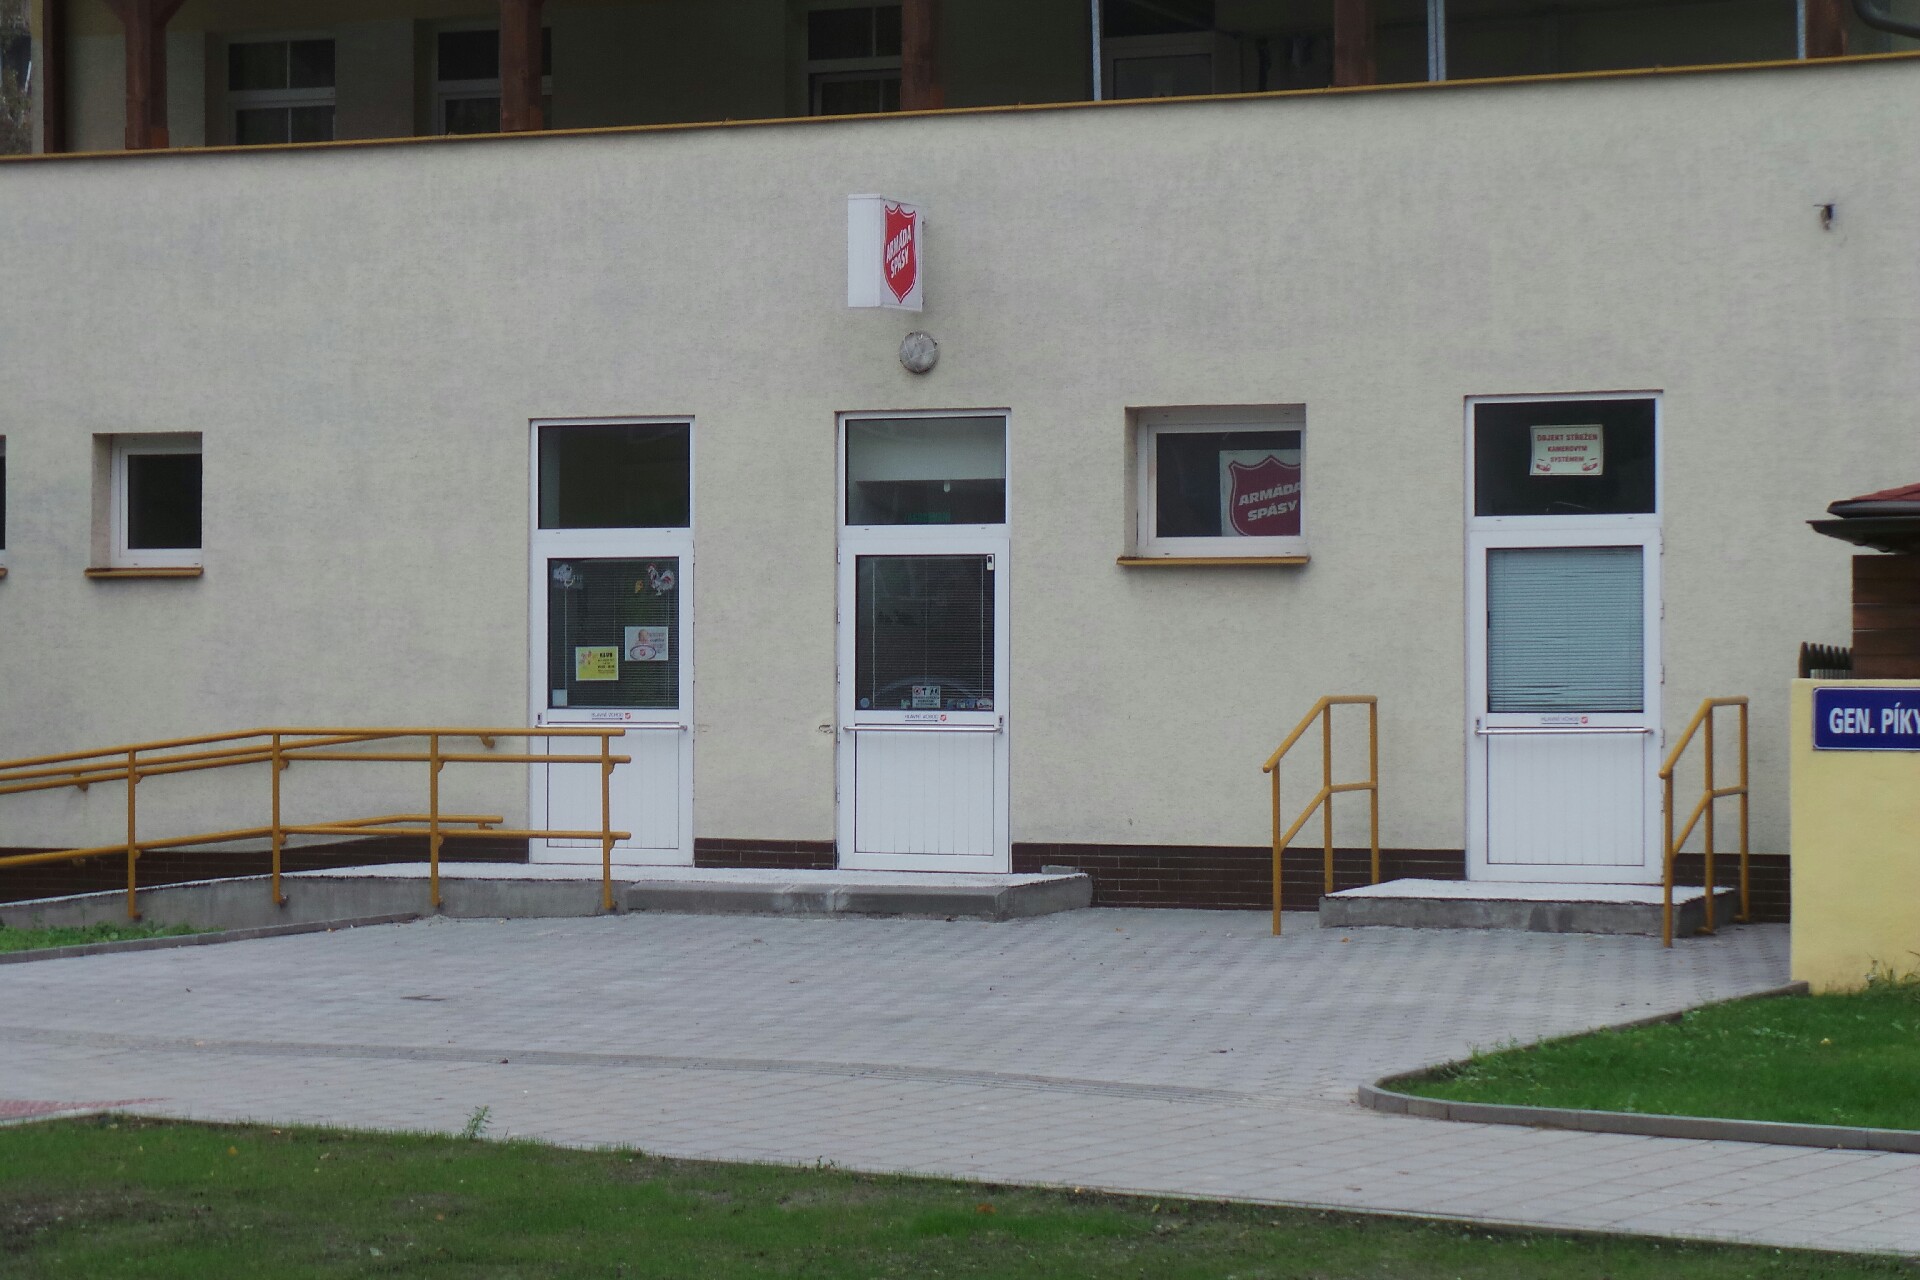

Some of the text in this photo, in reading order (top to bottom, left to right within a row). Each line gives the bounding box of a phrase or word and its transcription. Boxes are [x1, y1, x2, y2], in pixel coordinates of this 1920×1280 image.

[886, 224, 912, 263] ARMÁDA
[1537, 434, 1564, 442] OBJEKT
[1247, 500, 1298, 521] SPÁSY
[1829, 707, 1875, 734] GEN.
